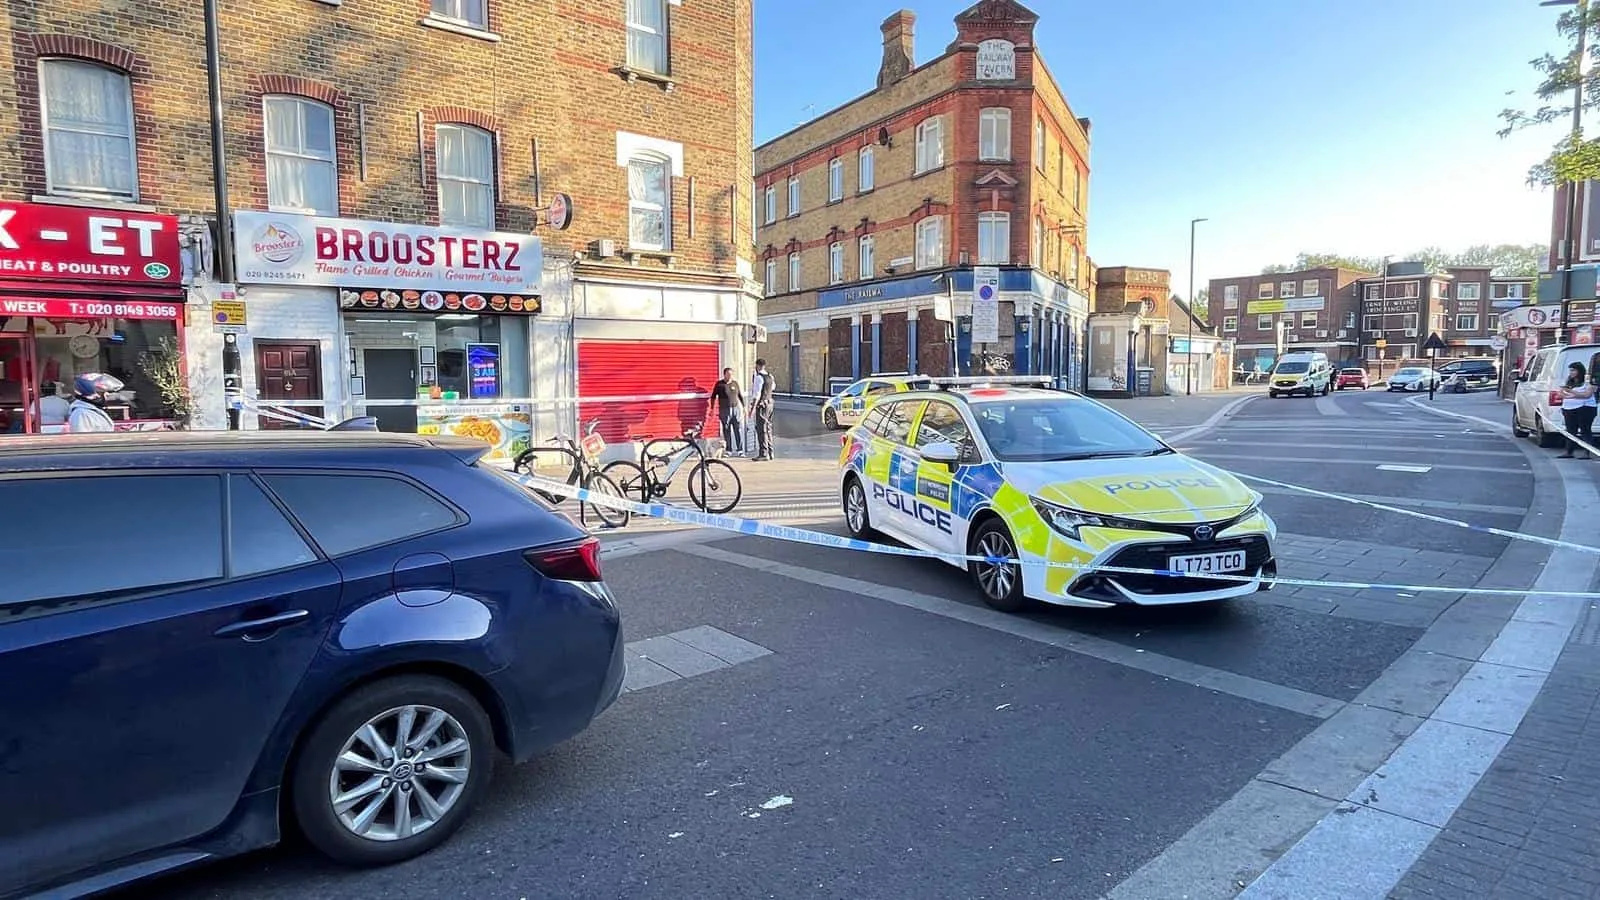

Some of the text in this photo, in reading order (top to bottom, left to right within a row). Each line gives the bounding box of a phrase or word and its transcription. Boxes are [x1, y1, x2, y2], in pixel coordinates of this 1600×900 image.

[986, 42, 1006, 50] THE
[977, 53, 1014, 62] RAILWAY
[979, 64, 1013, 73] TAVERN
[88, 216, 163, 257] ET
[315, 226, 521, 271] BROOSTERZ
[0, 259, 132, 276] EAT & POULTRY
[314, 262, 524, 285] Flame Grilled Chicken Gourmet Burgers
[4, 300, 48, 313] WEEK
[87, 304, 113, 315] 020
[114, 304, 144, 315] 8149
[1104, 478, 1222, 495] POLICE
[872, 482, 953, 536] POLICE
[1175, 556, 1212, 573] LT73
